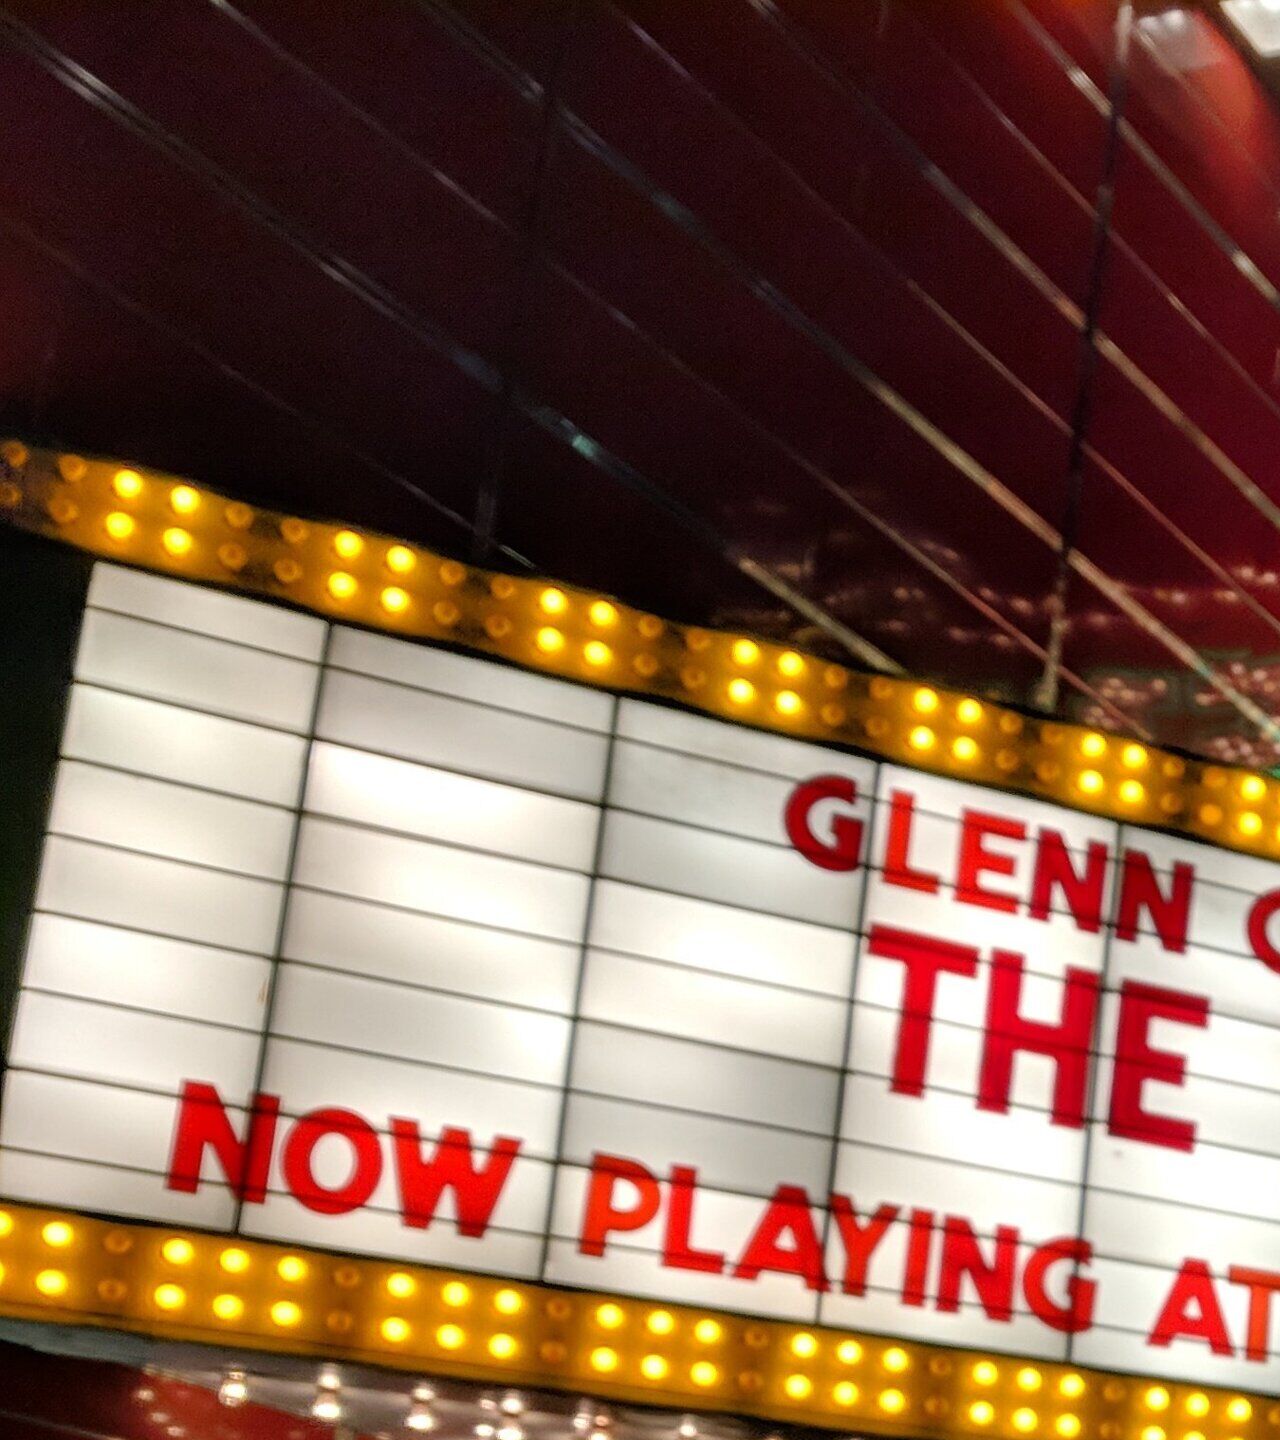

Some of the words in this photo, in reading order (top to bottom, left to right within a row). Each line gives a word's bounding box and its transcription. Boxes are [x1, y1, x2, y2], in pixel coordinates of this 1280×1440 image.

[786, 777, 1194, 954] GLENN
[868, 924, 1210, 1153] THE
[167, 1081, 522, 1238] NOW
[579, 1153, 1097, 1333] PLAYING
